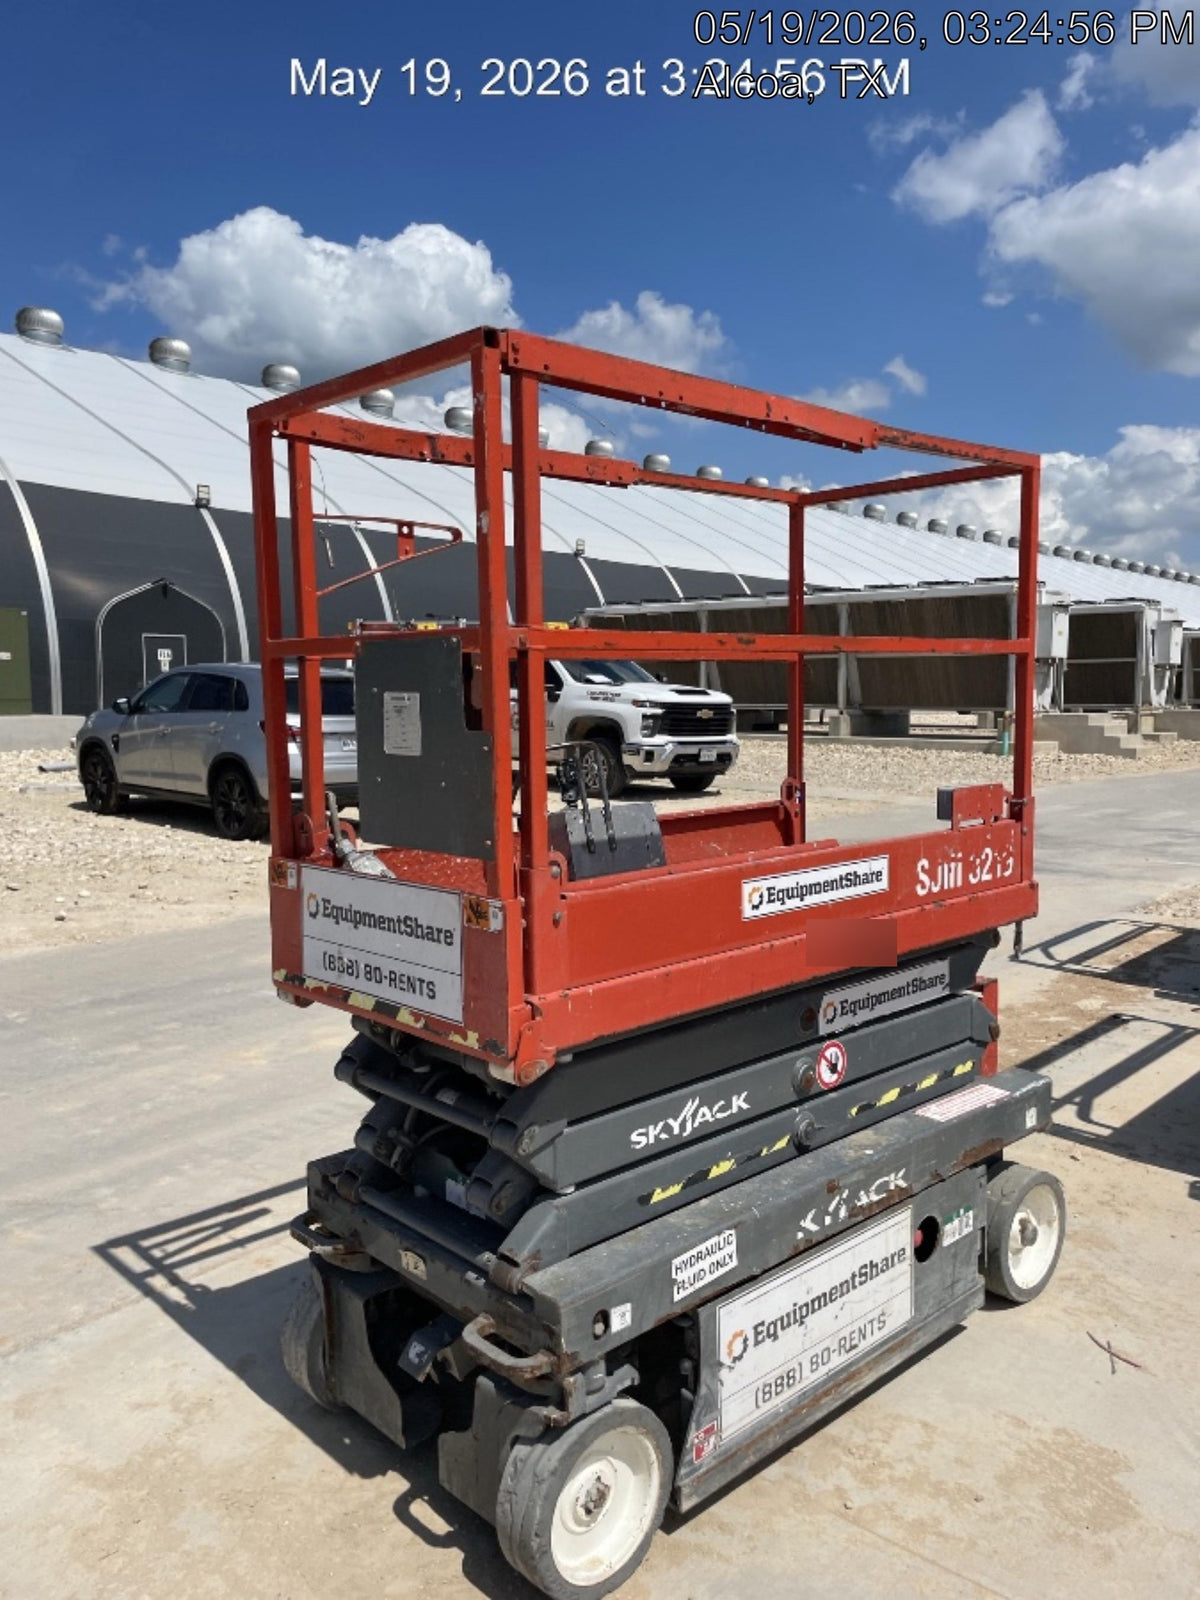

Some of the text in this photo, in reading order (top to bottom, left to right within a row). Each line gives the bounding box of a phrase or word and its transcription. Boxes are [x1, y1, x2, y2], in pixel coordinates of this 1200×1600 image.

[765, 867, 884, 906] EquipmentShare
[321, 897, 455, 947] EquipmentShare
[322, 950, 437, 1000] (888) 80-RENTS
[839, 973, 947, 1017] EquipmentShare
[630, 1091, 751, 1149] SKYJACK
[674, 1233, 733, 1277] HYDRAULIC
[676, 1251, 735, 1295] FLUID ONLY
[752, 1247, 906, 1347] EquipmentShare
[755, 1311, 888, 1408] (888) 80-RENTS
